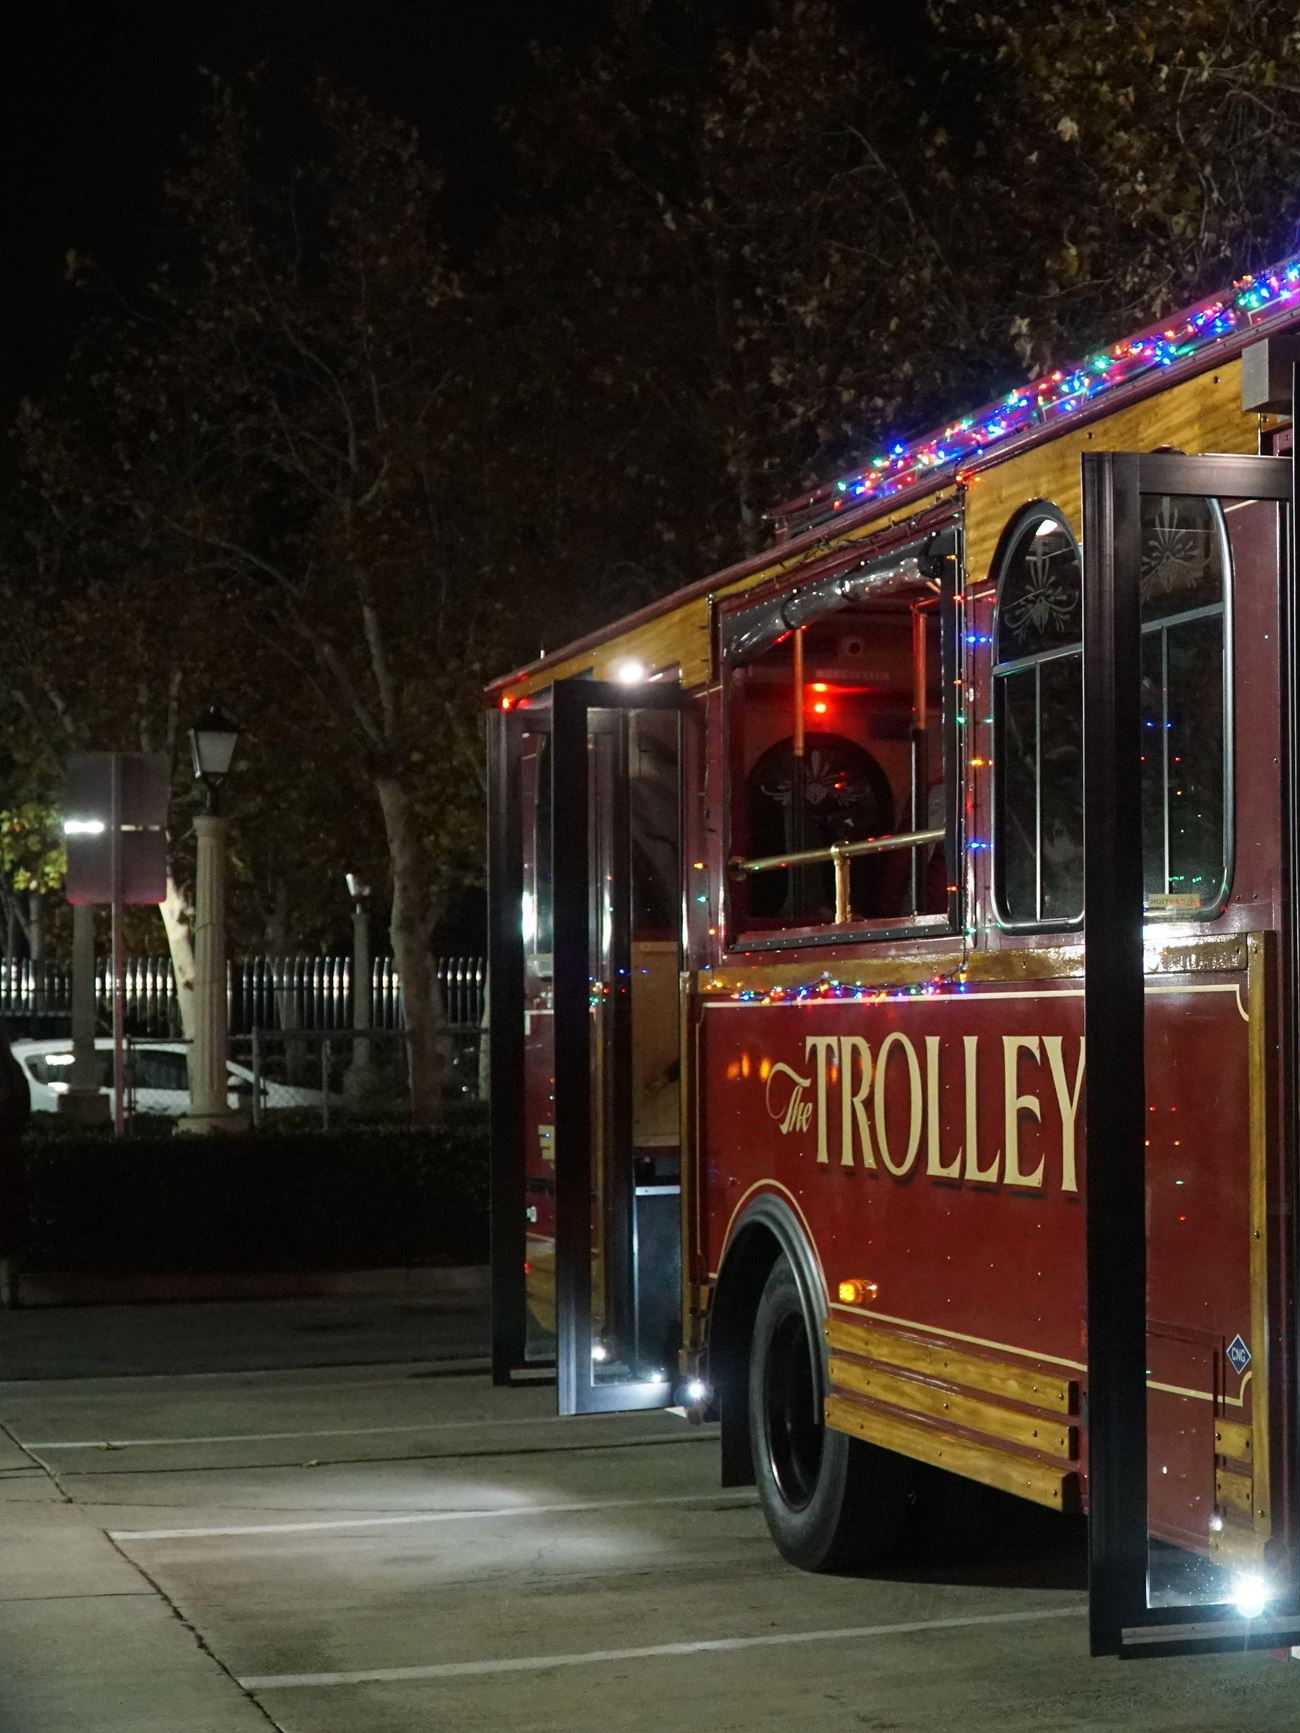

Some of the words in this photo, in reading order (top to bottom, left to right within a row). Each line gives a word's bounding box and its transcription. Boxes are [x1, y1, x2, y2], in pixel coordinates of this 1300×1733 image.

[766, 1062, 813, 1135] The
[804, 1031, 1086, 1192] TROLLEY
[1231, 1347, 1246, 1363] CNG
